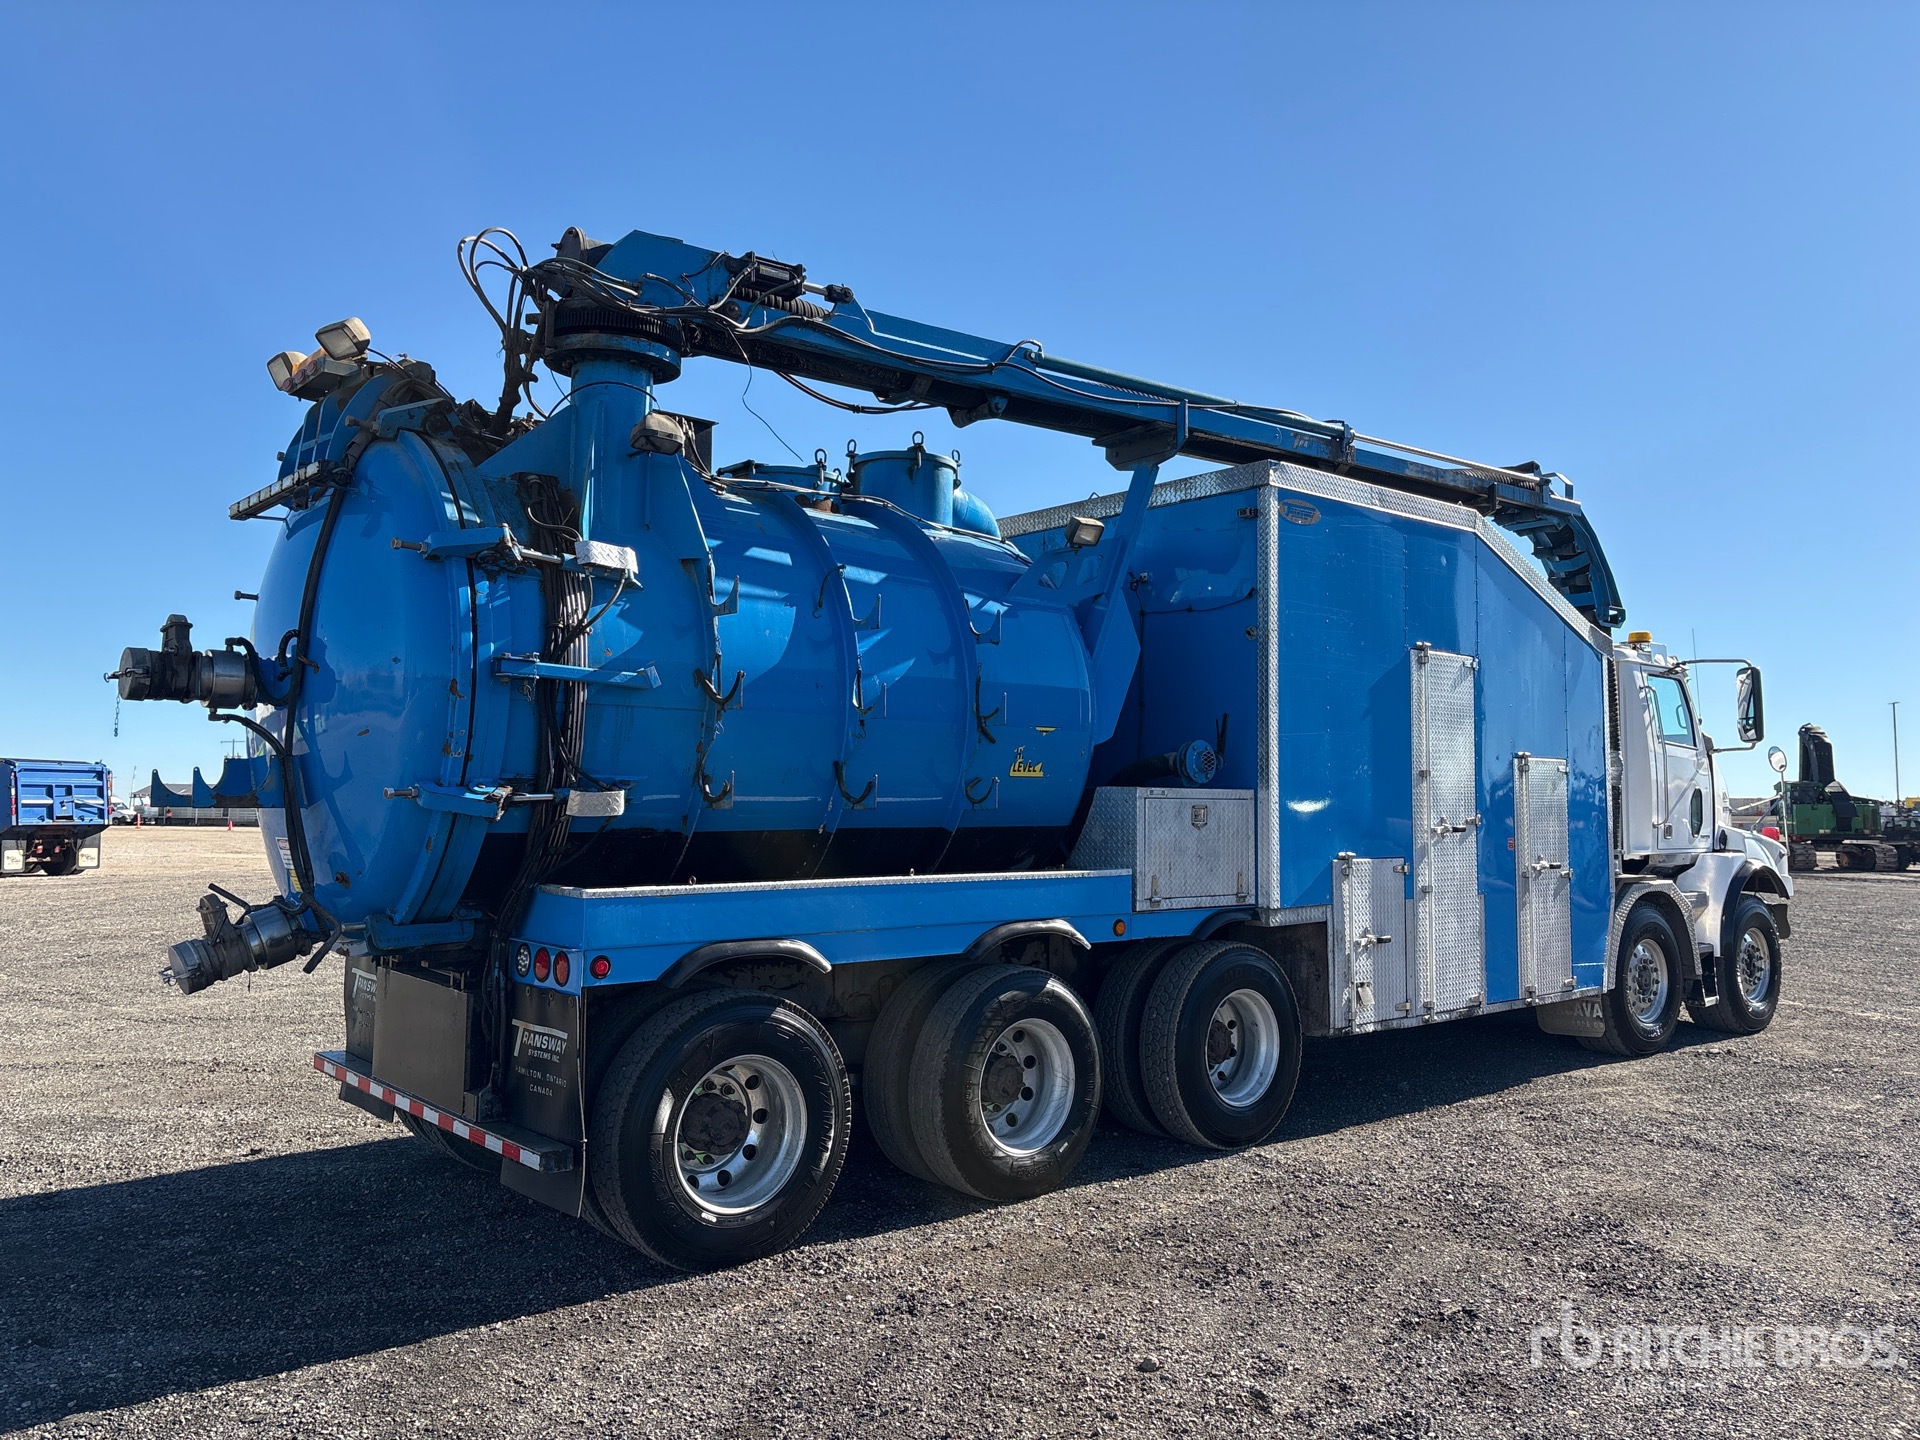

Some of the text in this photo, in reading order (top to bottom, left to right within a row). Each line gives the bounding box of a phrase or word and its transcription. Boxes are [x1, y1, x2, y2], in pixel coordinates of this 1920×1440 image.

[351, 967, 377, 998] TRANSW
[511, 1018, 569, 1057] TRANSWAY
[528, 1049, 560, 1063] SYSTEMS INC.
[546, 1073, 567, 1088] ONTARIO
[529, 1083, 553, 1097] CANADA
